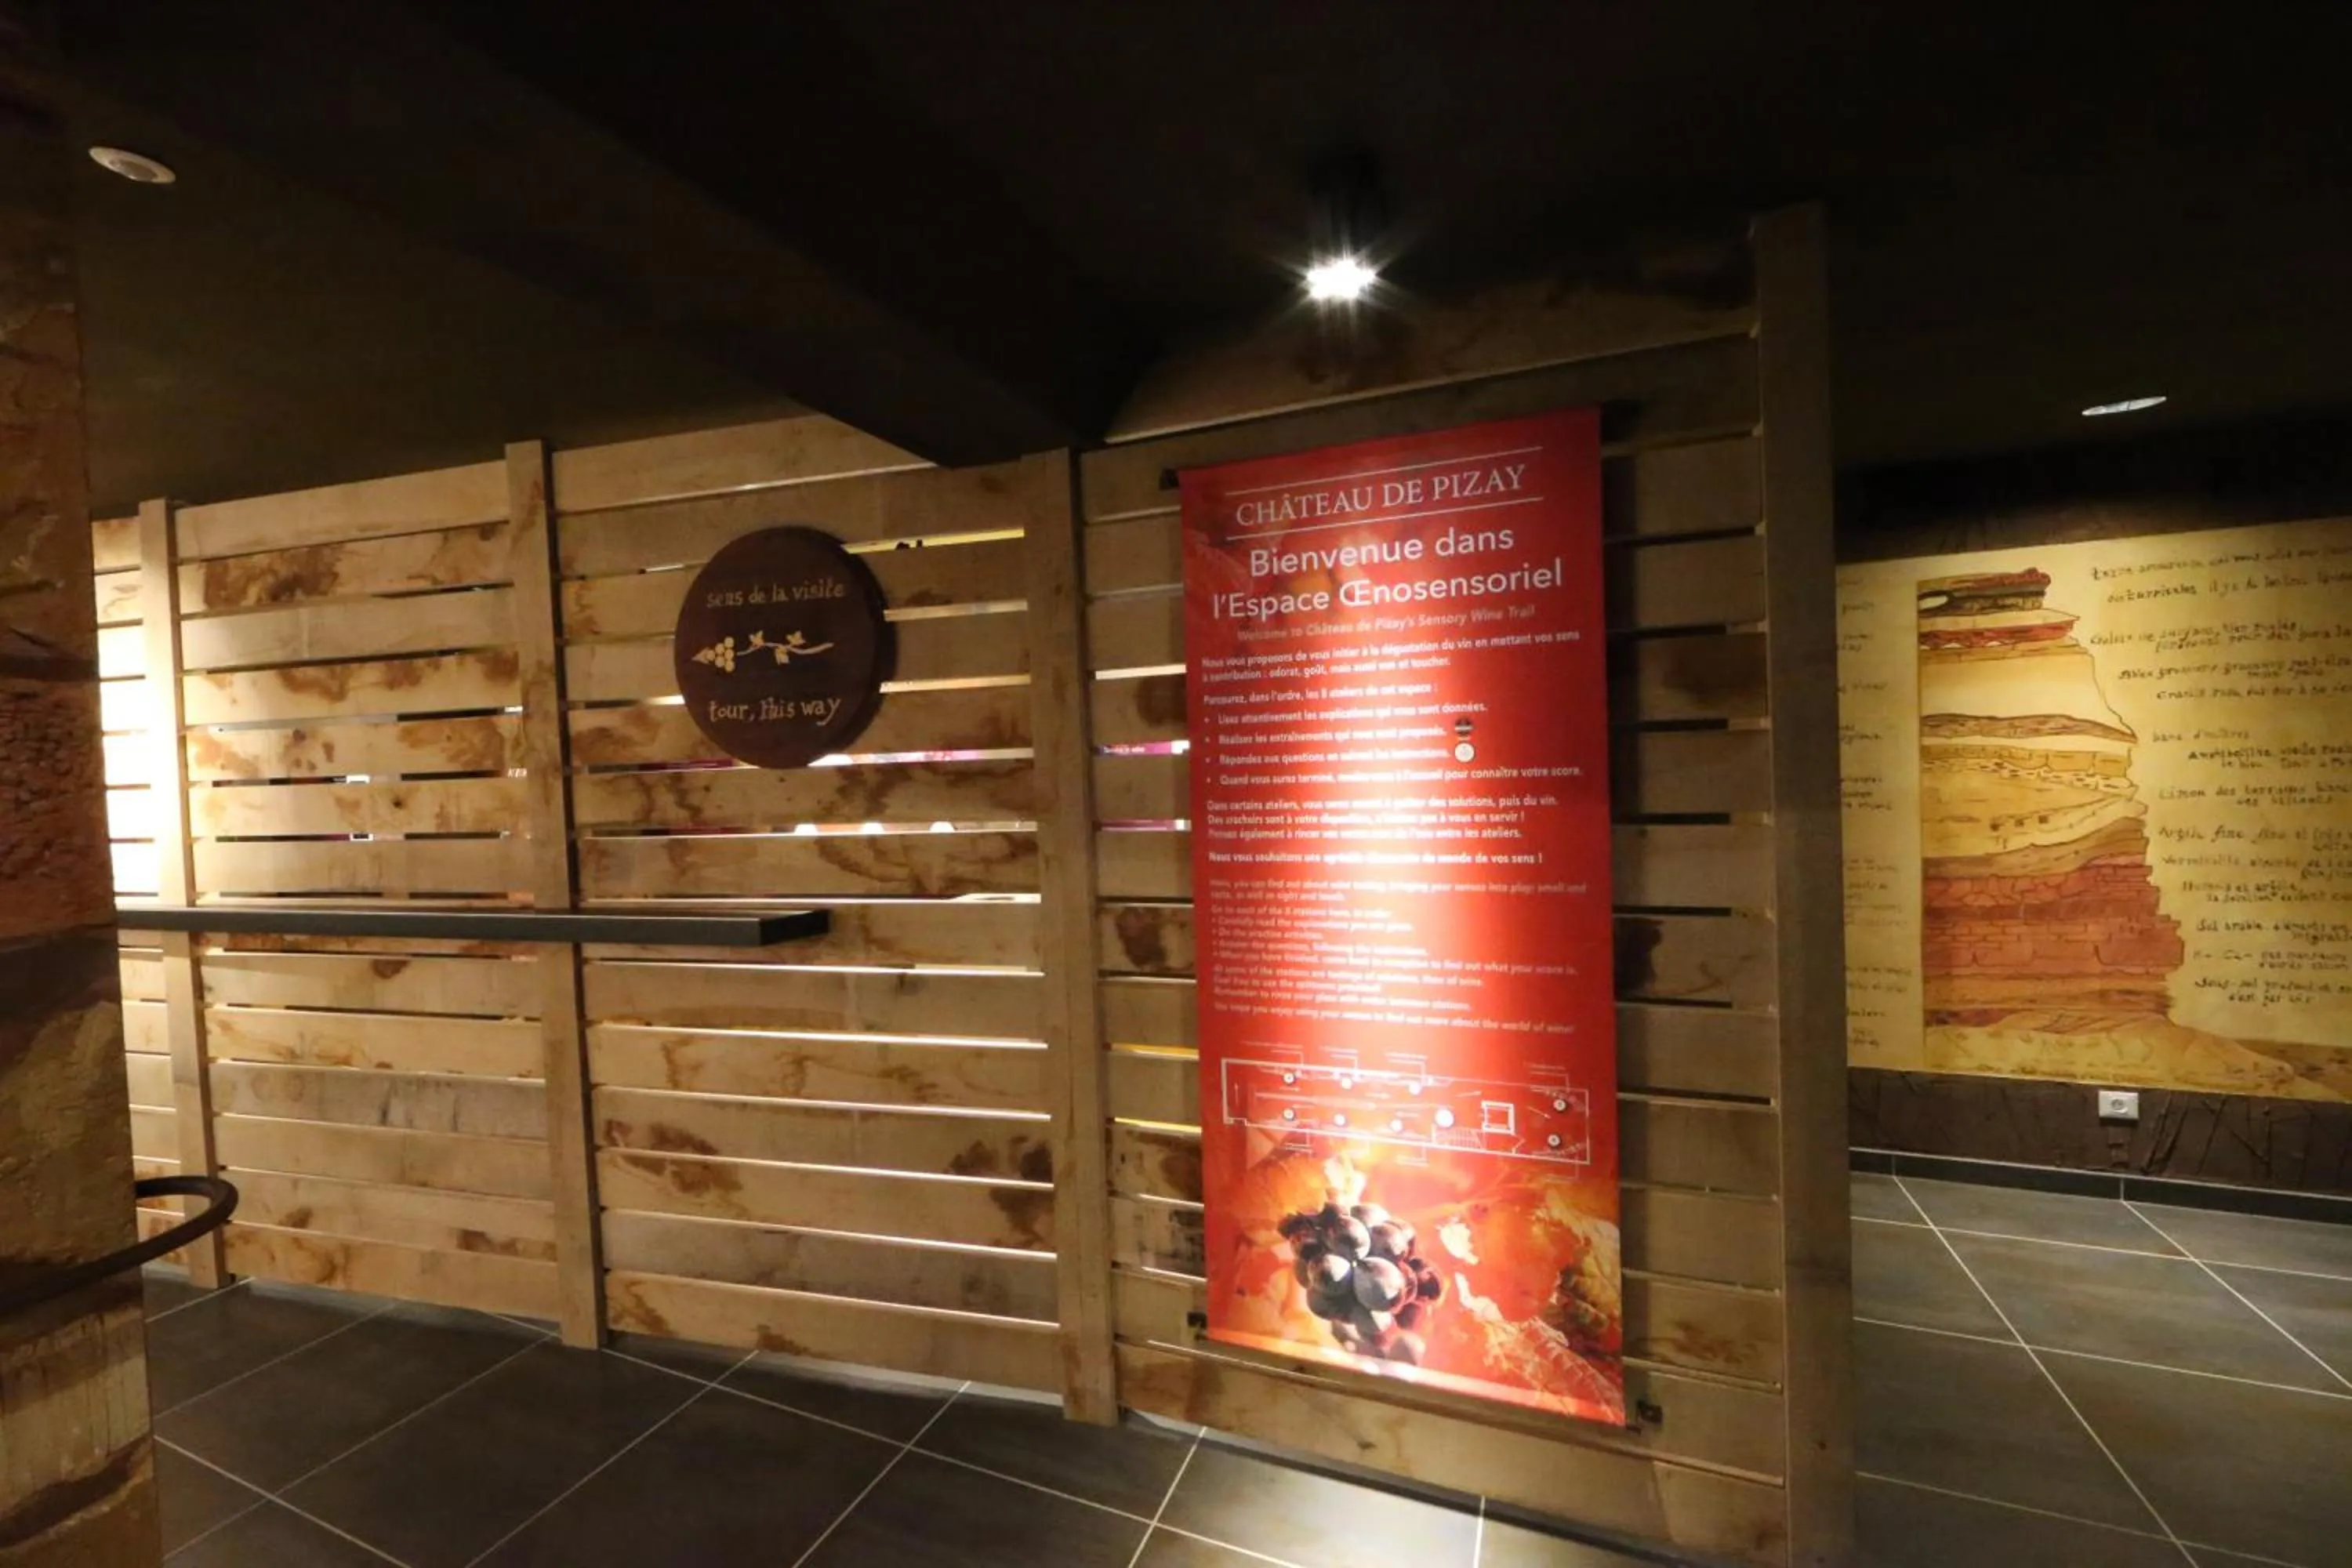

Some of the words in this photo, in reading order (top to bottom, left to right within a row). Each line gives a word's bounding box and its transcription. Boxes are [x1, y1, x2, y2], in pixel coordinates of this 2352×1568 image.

[1236, 487, 1373, 526] CHÂTEAU
[1383, 478, 1423, 508] DE
[1432, 464, 1526, 501] PIZAY
[1250, 538, 1424, 577] Bienvenue
[1435, 527, 1514, 557] dans
[707, 591, 743, 608] sens
[748, 584, 765, 604] de
[772, 583, 789, 602] la
[793, 575, 845, 601] visite
[1213, 588, 1330, 622] l'Espace
[1339, 557, 1563, 608] Œnosensoriel
[1237, 630, 1287, 641] Welcome
[1306, 622, 1354, 636] Château
[1357, 620, 1372, 632] de
[1417, 612, 1467, 626] Sensory
[1470, 608, 1503, 622] Wine
[1508, 604, 1535, 619] Trail
[1247, 653, 1293, 667] proposons
[1295, 650, 1307, 660] de
[1442, 638, 1454, 650] du
[1457, 637, 1472, 648] vin
[1475, 639, 1488, 648] en
[1490, 635, 1531, 647] mettant
[1534, 634, 1552, 643] vos
[1556, 631, 1580, 641] sens
[710, 700, 756, 722] tour,
[801, 698, 841, 726] way
[1471, 765, 1519, 779] connaître
[1520, 767, 1548, 776] votre
[1499, 795, 1520, 808] puis
[1523, 793, 1537, 806] du
[1475, 852, 1489, 863] de
[1490, 855, 1508, 863] vos
